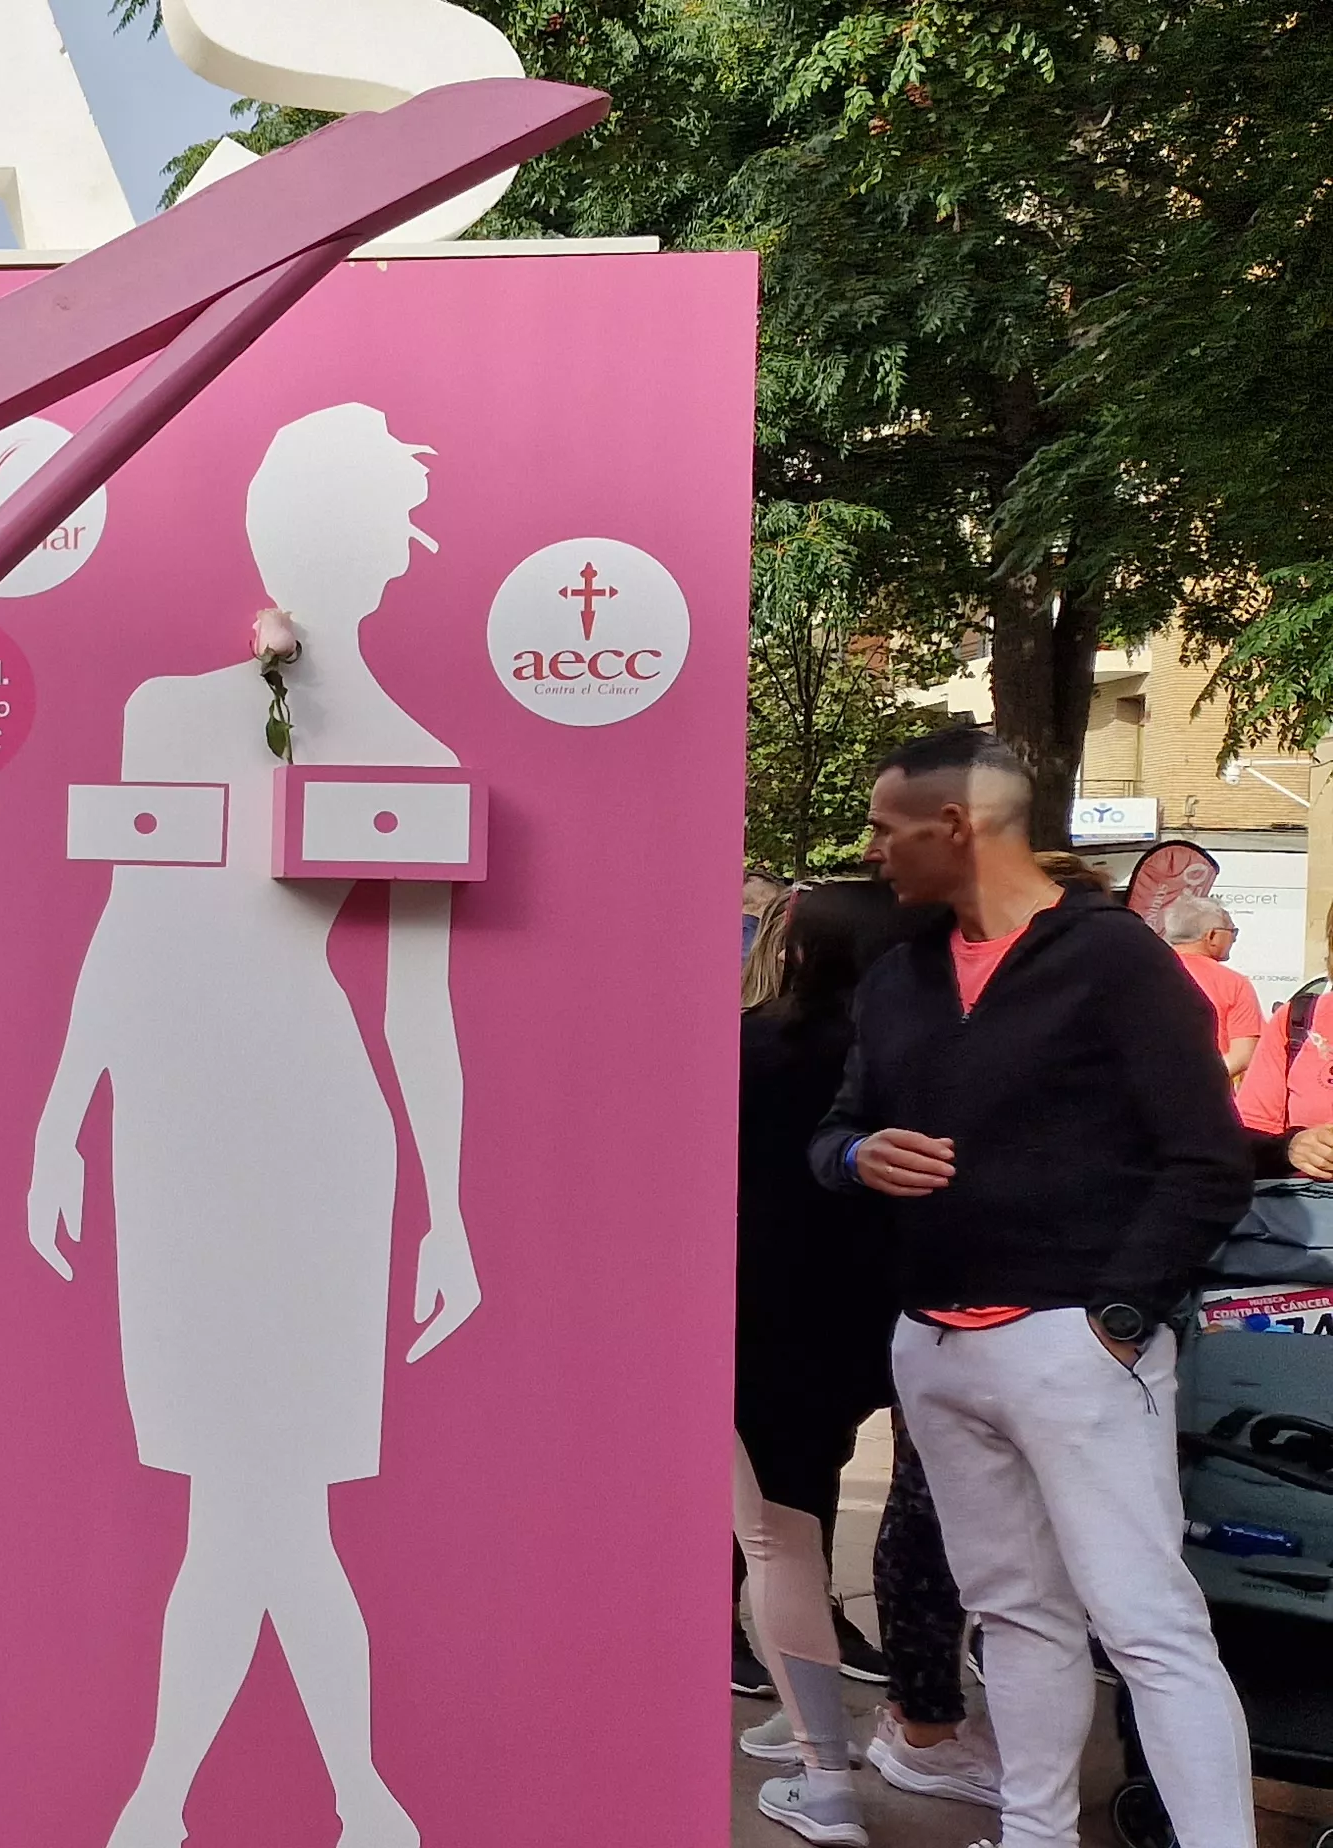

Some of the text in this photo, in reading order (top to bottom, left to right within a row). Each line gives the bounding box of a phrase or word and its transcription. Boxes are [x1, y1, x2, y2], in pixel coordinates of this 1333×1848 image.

[512, 649, 663, 681] aecc
[534, 683, 575, 695] Contra
[581, 683, 592, 695] el
[1213, 1297, 1332, 1319] CONTRA EL CÁNCER
[1249, 1296, 1286, 1306] HUESCA
